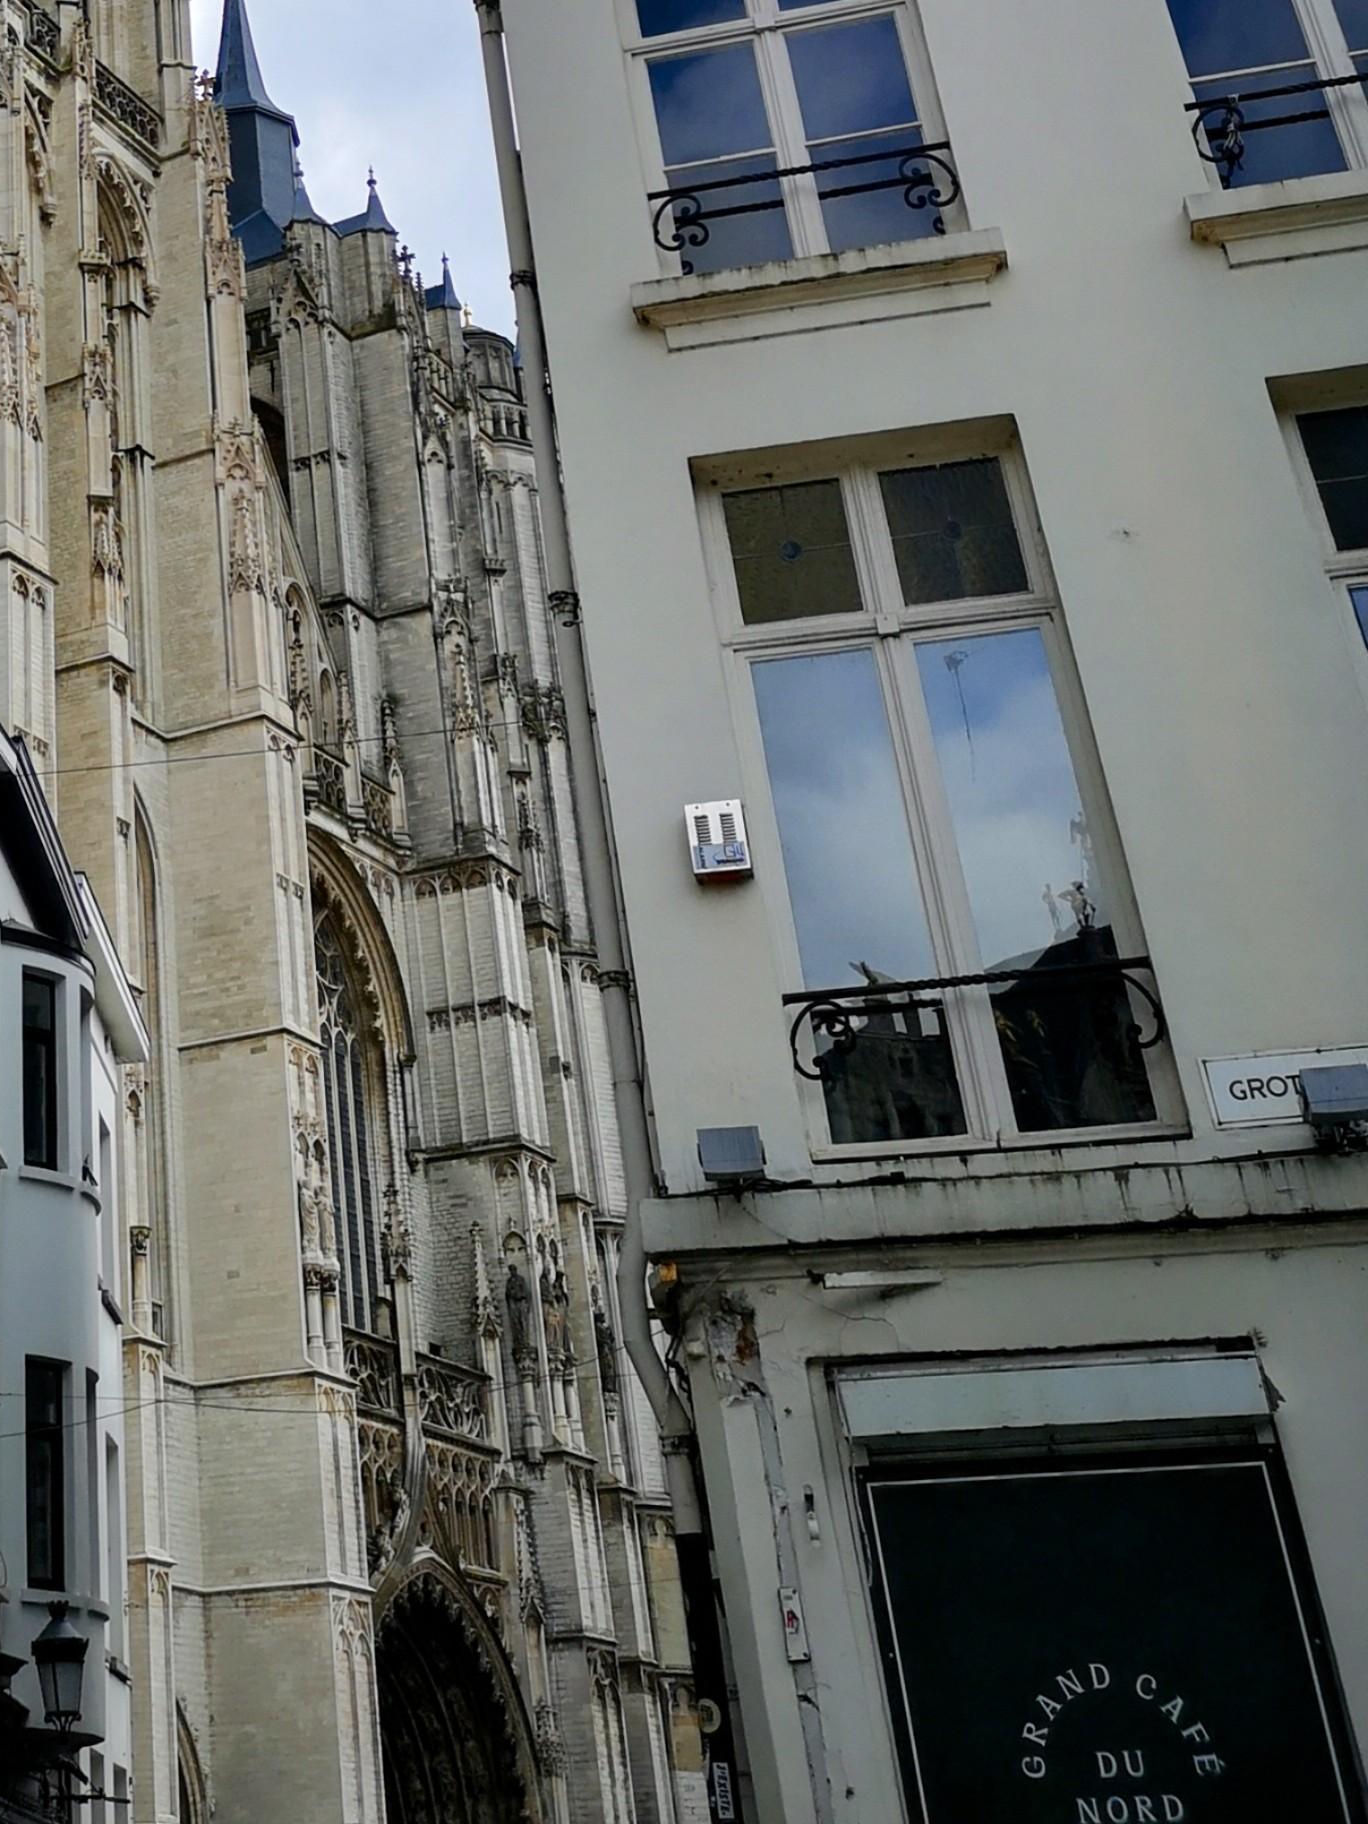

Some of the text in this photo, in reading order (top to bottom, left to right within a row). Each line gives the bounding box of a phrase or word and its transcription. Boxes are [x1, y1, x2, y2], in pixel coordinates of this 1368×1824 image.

[1022, 1663, 1226, 1778] GRAND CAFÉ
[1095, 1749, 1145, 1778] DU
[1076, 1794, 1184, 1824] NORD
